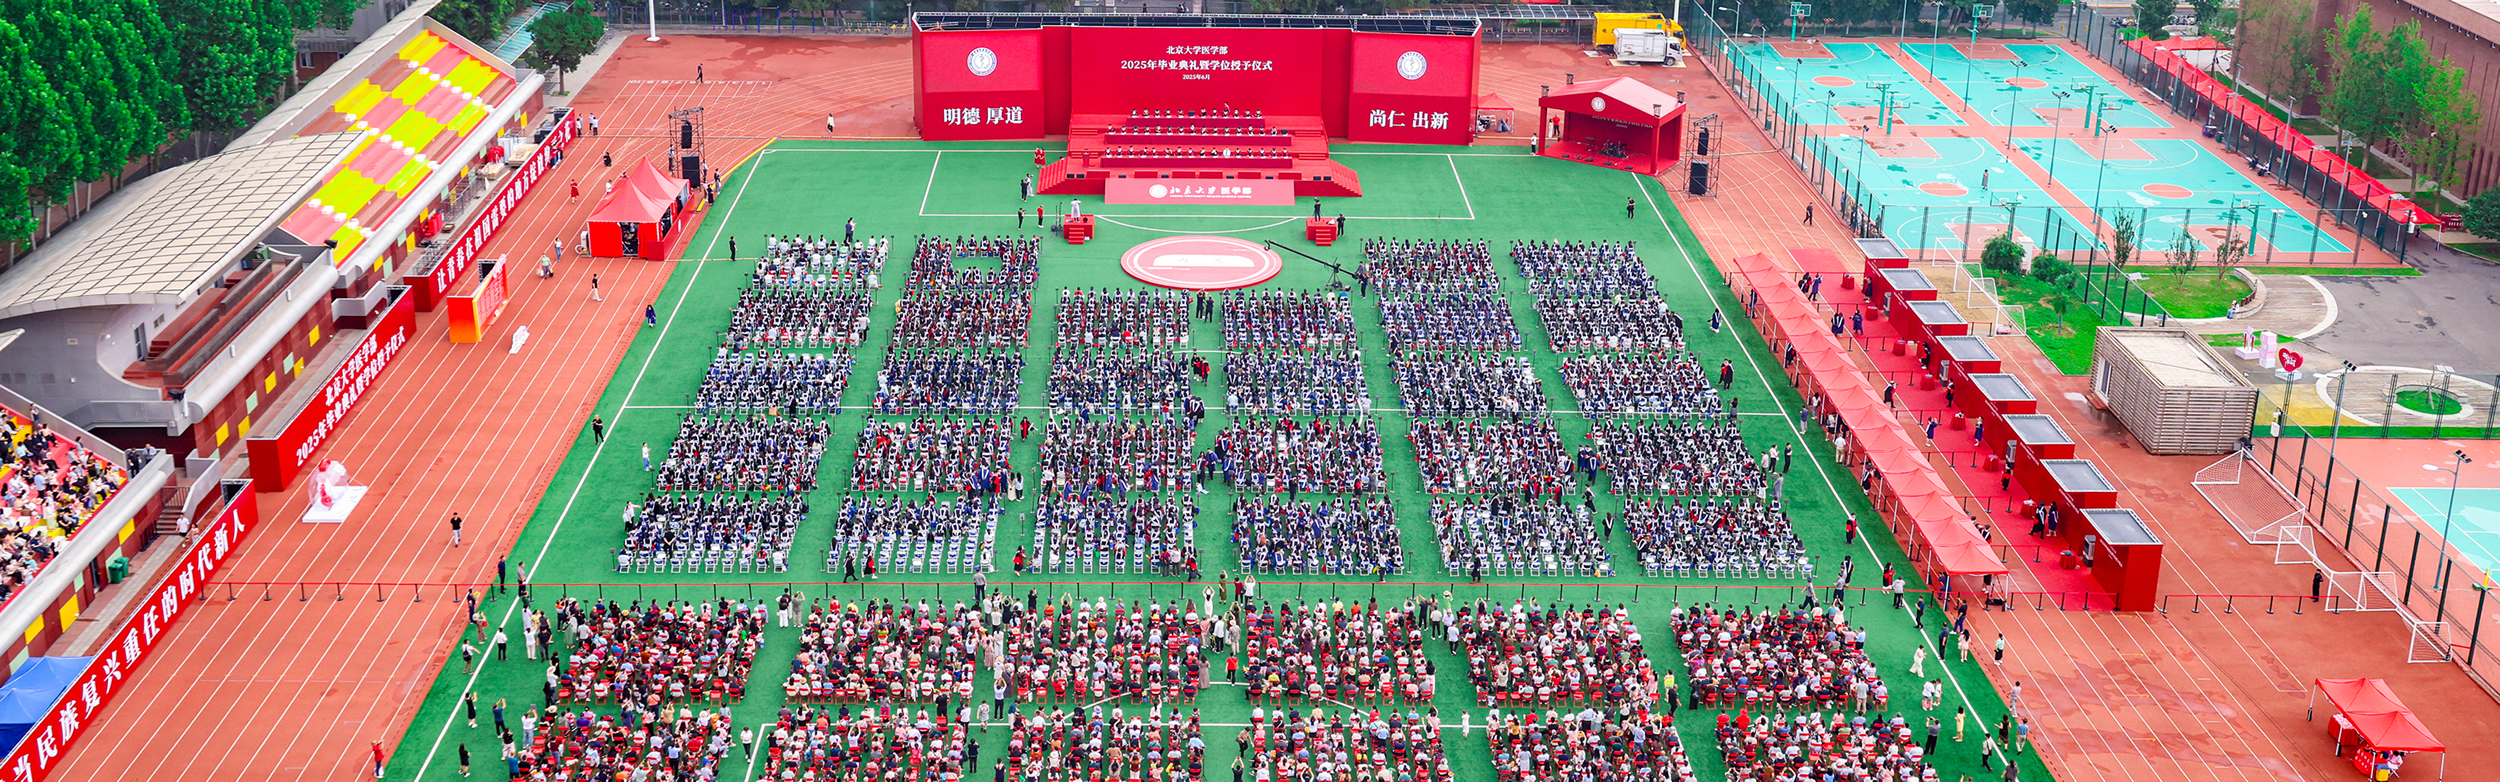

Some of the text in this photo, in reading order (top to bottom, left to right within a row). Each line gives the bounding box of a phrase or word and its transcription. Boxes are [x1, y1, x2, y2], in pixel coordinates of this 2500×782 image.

[1165, 45, 1229, 55] 北京大学医学部
[1120, 59, 1273, 71] 2025年毕业典礼暨学位授予仪式
[1182, 73, 1211, 81] 2025年6月
[943, 106, 1023, 126] 明德 厚道
[1369, 109, 1449, 130] 尚仁 出新
[325, 333, 379, 407] 北京大学医学部
[296, 325, 406, 467] 2025年毕业典礼暨学位授予仪式
[0, 508, 246, 782] 当民族复兴重任的时代新人
